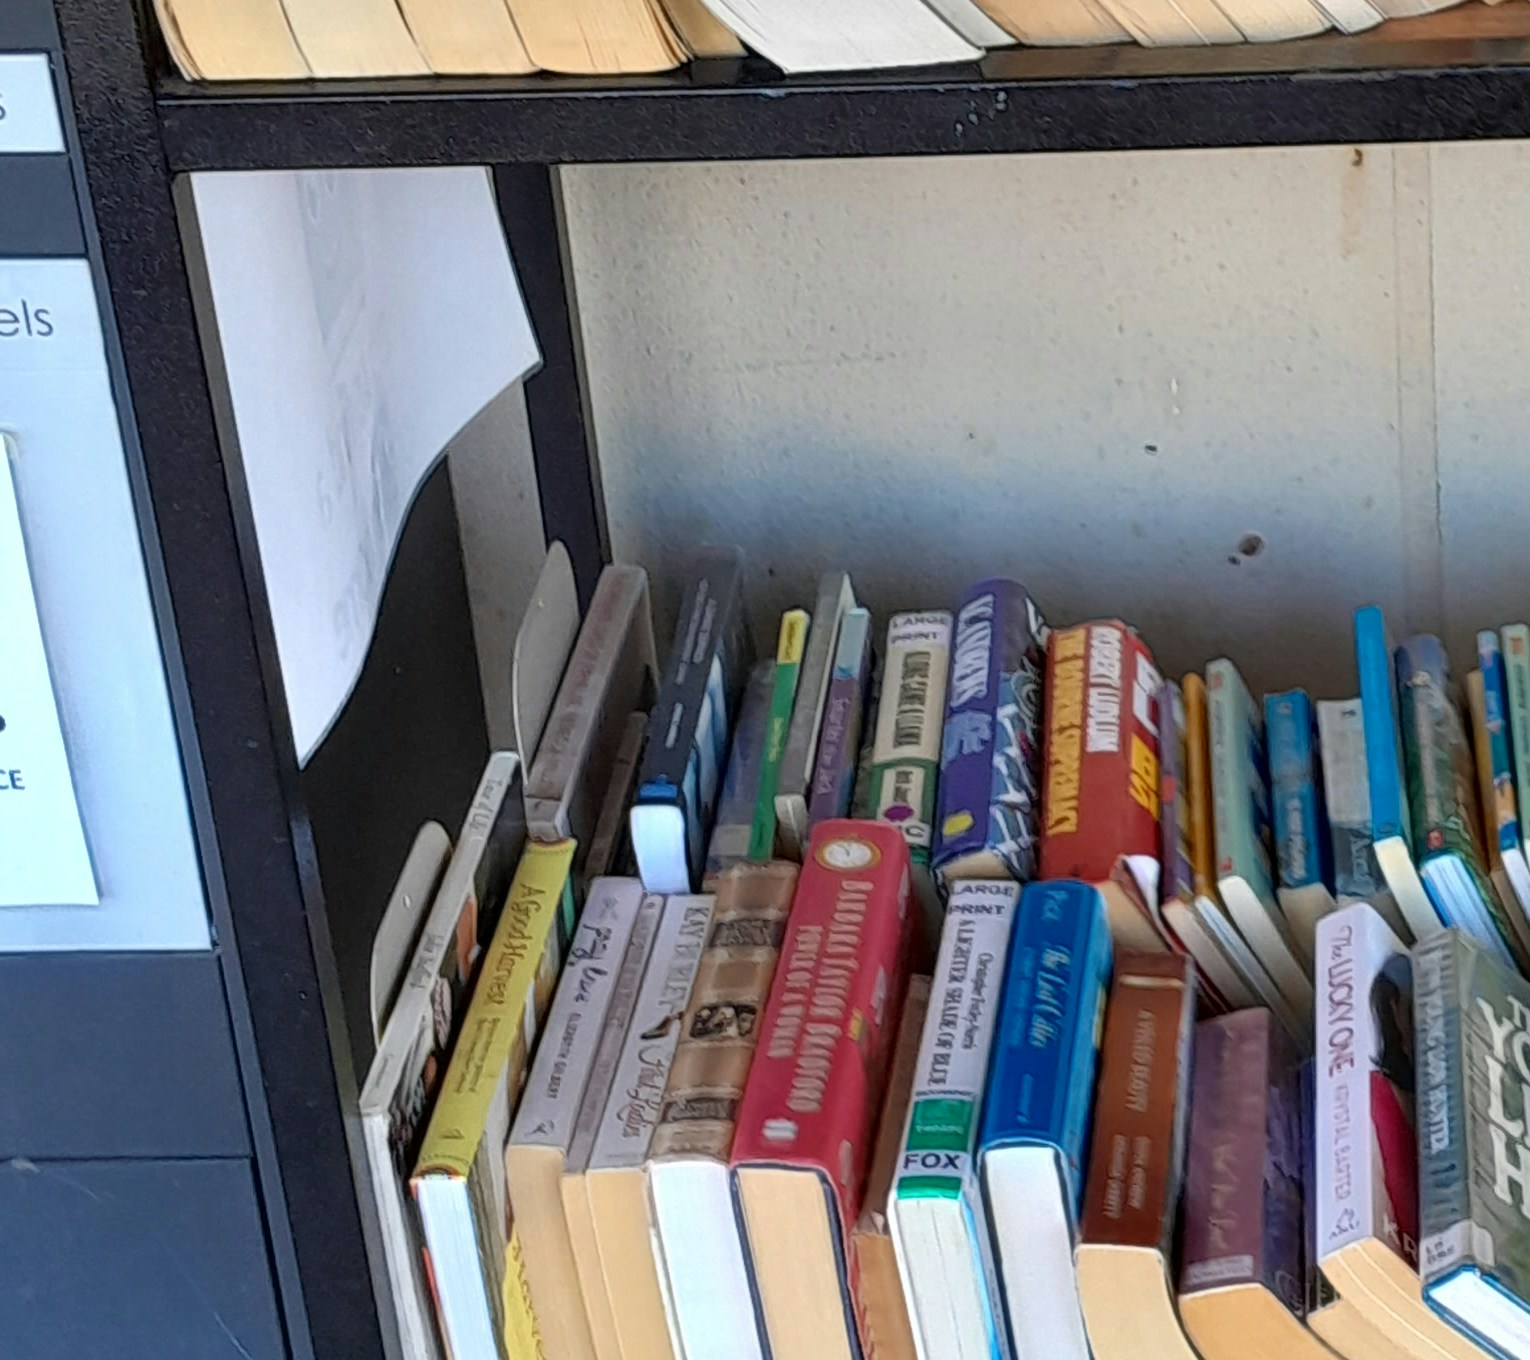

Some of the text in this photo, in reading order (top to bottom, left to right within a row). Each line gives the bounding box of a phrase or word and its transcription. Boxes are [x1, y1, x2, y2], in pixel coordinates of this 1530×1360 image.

[889, 630, 939, 644] PRINT
[1085, 626, 1123, 753] ROBERT LUDLUM
[519, 883, 546, 902] A
[951, 884, 1015, 898] LARGE
[503, 898, 541, 943] Good
[680, 906, 709, 939] KAY
[948, 902, 1006, 918] PRINT
[486, 936, 528, 1006] Harvest
[786, 879, 874, 1113] BARBARA TAYLOR BRADFORD
[939, 986, 963, 1034] SHADE
[1328, 924, 1356, 1079] The LUCKY ONE
[934, 1033, 957, 1053] OF
[927, 1051, 951, 1088] BLUE
[903, 1152, 962, 1170] FOX
